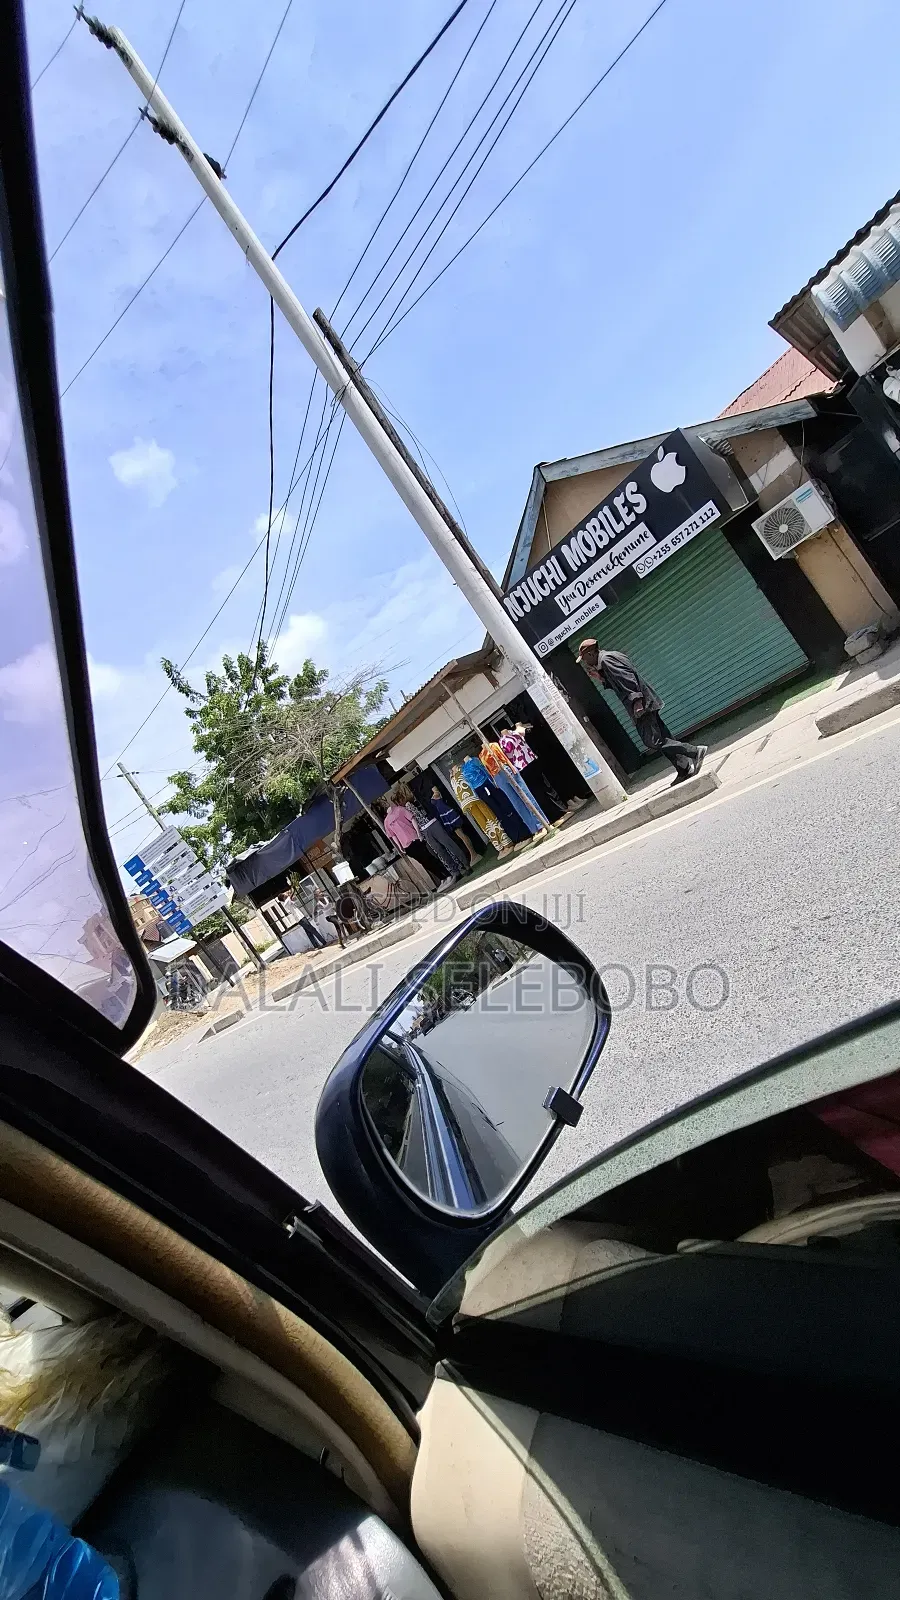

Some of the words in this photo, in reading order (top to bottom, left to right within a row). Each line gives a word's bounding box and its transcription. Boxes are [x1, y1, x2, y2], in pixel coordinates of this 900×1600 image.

[503, 555, 567, 621] NJUCHI
[561, 481, 647, 571] MOBILES
[653, 543, 671, 561] +255
[671, 531, 685, 546] 657
[684, 520, 700, 536] 271
[698, 507, 716, 524] 112
[559, 592, 577, 612] You
